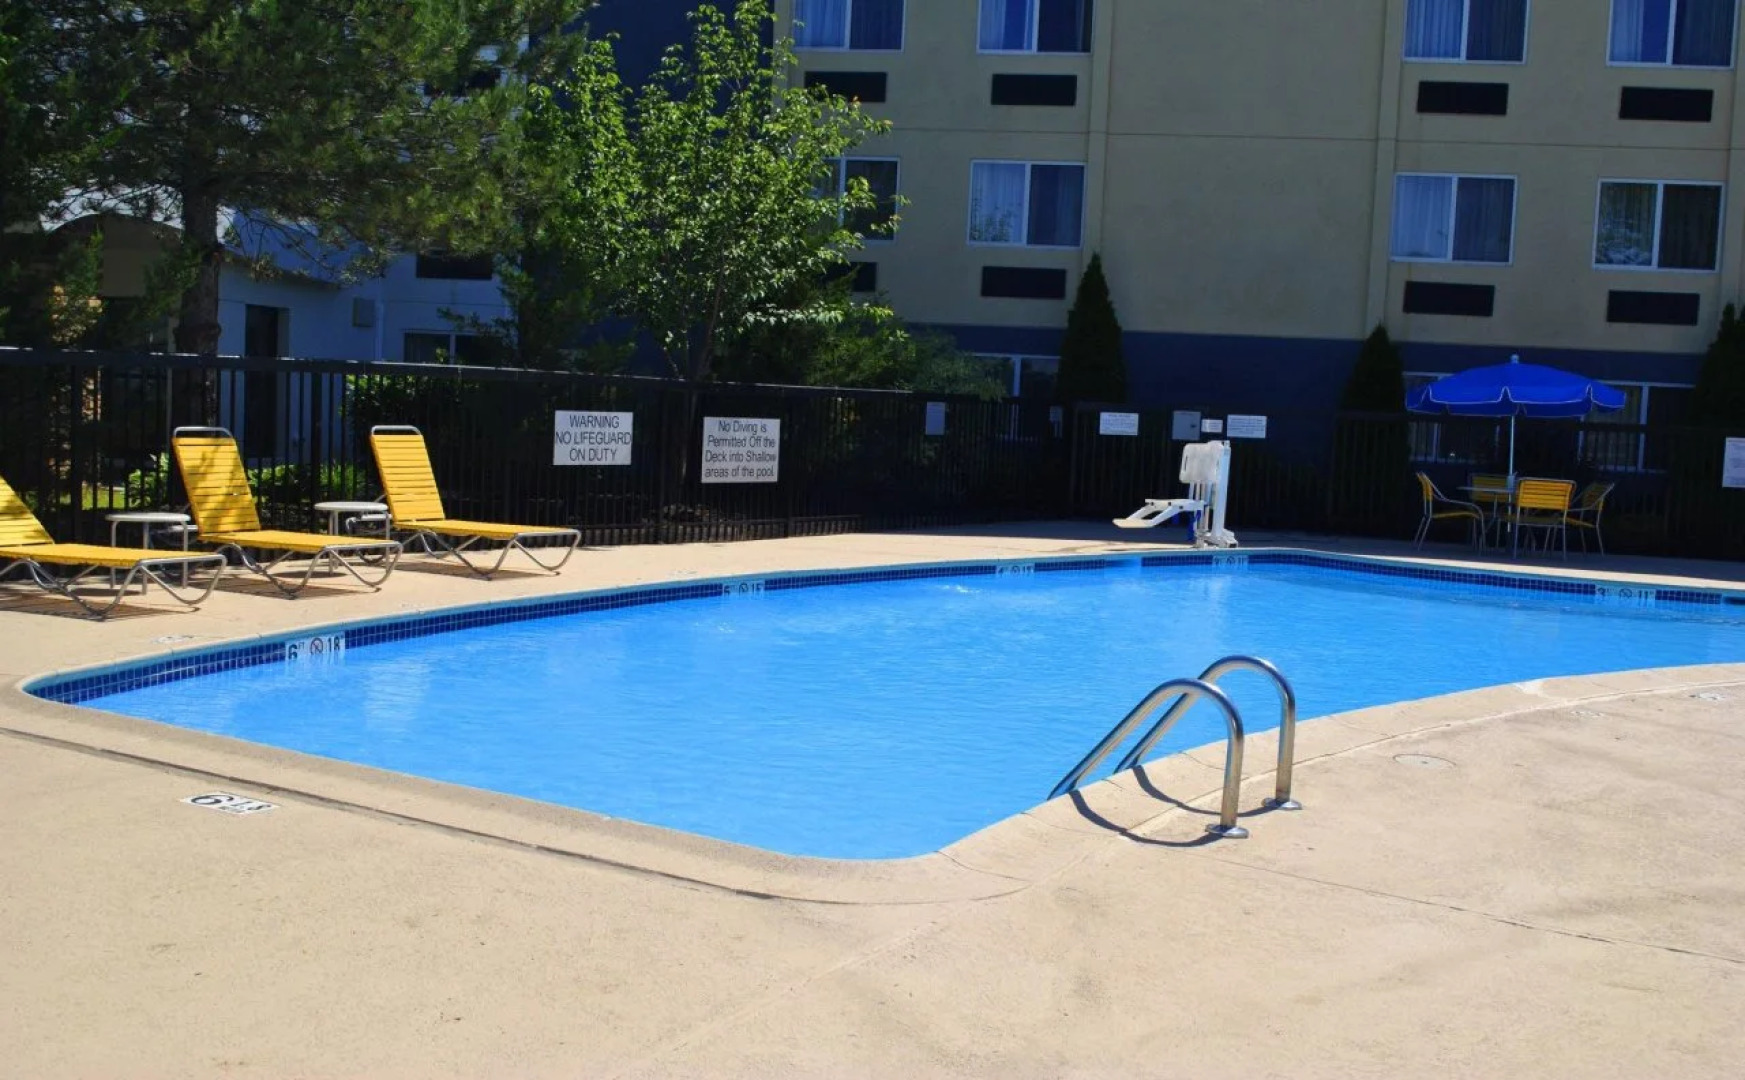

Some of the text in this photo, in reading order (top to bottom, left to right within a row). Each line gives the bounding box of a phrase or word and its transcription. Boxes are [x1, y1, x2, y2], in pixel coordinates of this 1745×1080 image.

[569, 414, 620, 429] WARNING
[718, 420, 767, 436] No Diving is
[555, 430, 632, 445] NO LIFEGUARD
[707, 434, 776, 448] Permitted Off the
[569, 448, 617, 462] ON DUTY
[704, 449, 777, 463] Deck into Shallow
[704, 468, 729, 478] areas
[731, 465, 740, 477] of
[741, 465, 755, 477] the
[288, 644, 298, 660] 6
[191, 794, 234, 805] 6
